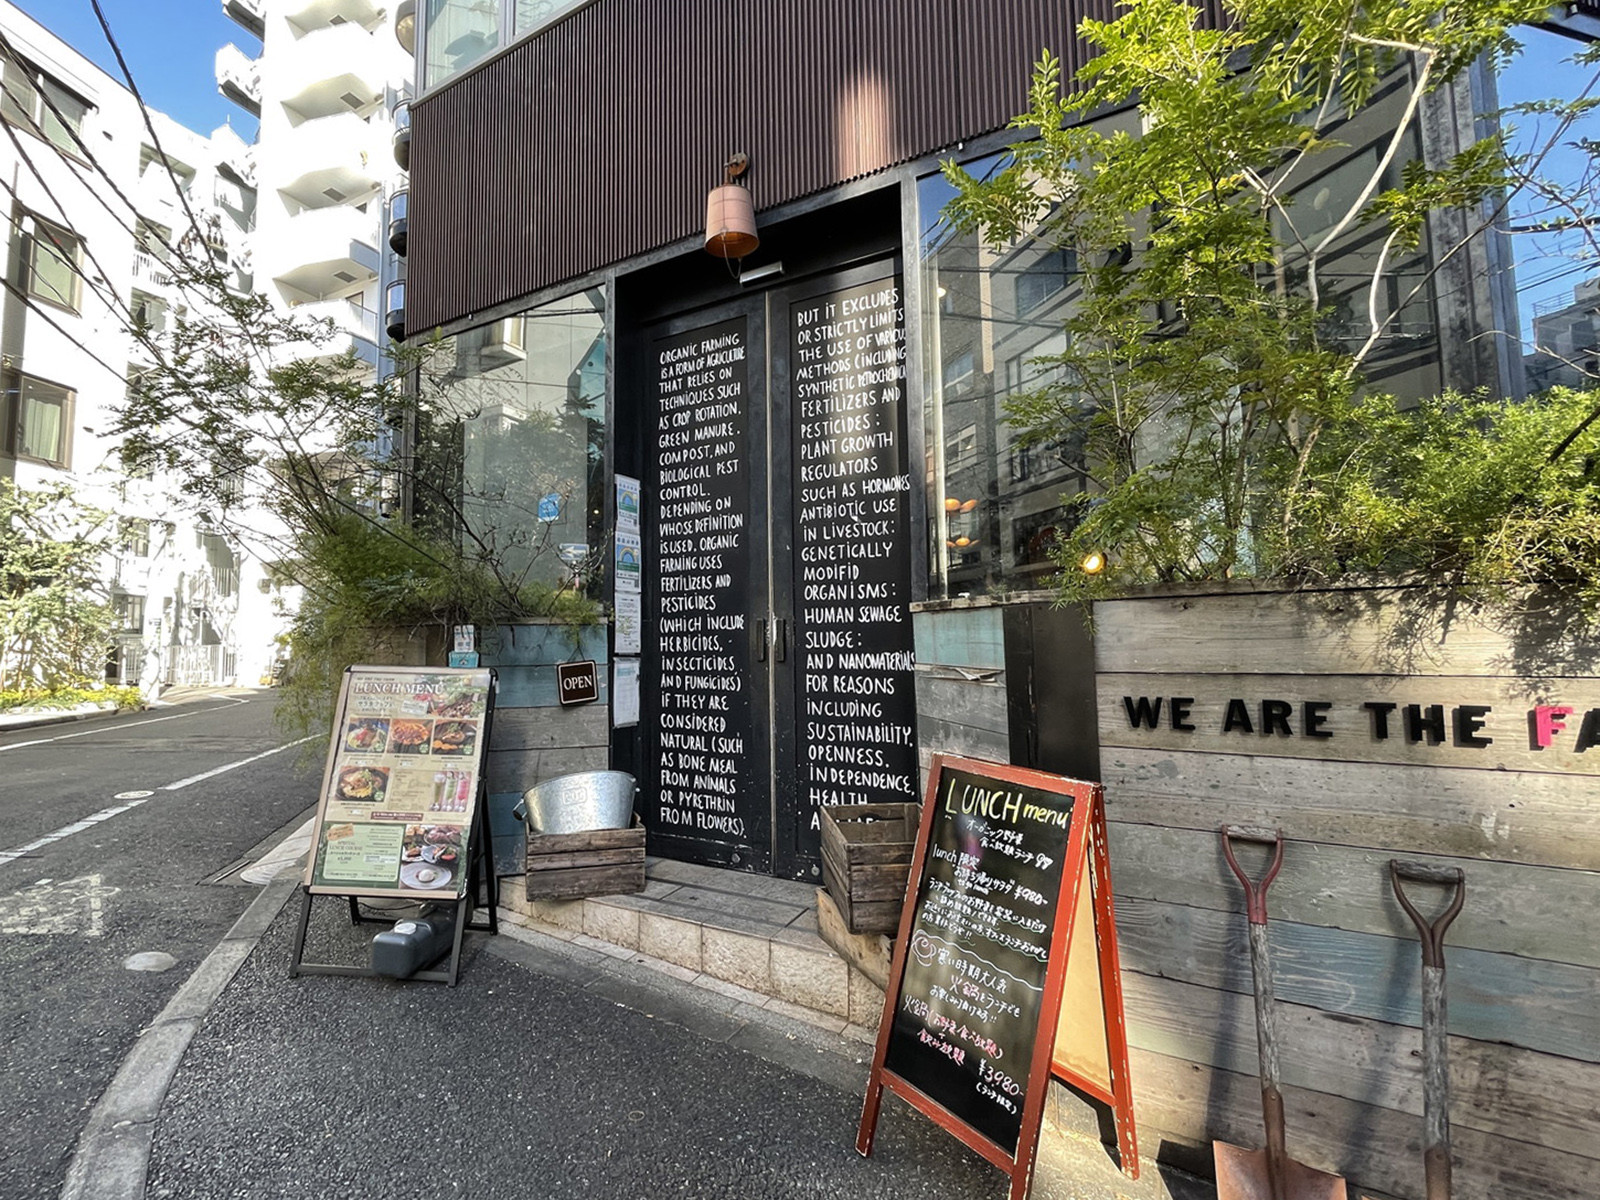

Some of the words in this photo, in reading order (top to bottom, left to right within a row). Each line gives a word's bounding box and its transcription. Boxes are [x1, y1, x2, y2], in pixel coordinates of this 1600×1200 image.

[798, 308, 819, 327] BUT
[825, 303, 836, 319] IT
[842, 288, 899, 316] EXCLUDES
[798, 330, 811, 345] OR
[814, 317, 867, 342] STRICTLY
[870, 308, 904, 329] LIMITS
[660, 342, 698, 364] ORGANIC
[702, 333, 740, 354] FARMING
[799, 347, 823, 363] THE
[827, 339, 852, 356] USE
[857, 333, 873, 350] OF
[661, 368, 668, 379] IS
[669, 366, 674, 377] A
[676, 360, 695, 376] FORM
[696, 358, 705, 370] OF
[796, 358, 851, 381] METHODS
[659, 378, 683, 394] THAT
[688, 372, 715, 388] RELIES
[719, 367, 732, 379] ON
[798, 374, 855, 398] SYNTHETIC
[660, 388, 714, 412] TECHNIQUES
[717, 382, 740, 399] SUCH
[802, 390, 877, 418] FERTILIZERS
[882, 386, 901, 403] AND
[659, 415, 669, 430] AS
[672, 410, 691, 427] CROP
[659, 430, 690, 448] GREEN
[802, 439, 837, 460] PLANT
[841, 431, 893, 453] GROWTH
[660, 465, 711, 485] BIOLOGICAL
[717, 459, 739, 476] PEST
[802, 456, 878, 482] REGULATORS
[801, 485, 836, 502] SUCH
[842, 482, 856, 498] AS
[863, 474, 910, 495] HORMONES
[661, 499, 712, 519] DEPENDING
[716, 496, 731, 510] ON
[800, 500, 866, 524] ANTIBIOTIC
[874, 498, 897, 513] USE
[660, 520, 693, 537] WHOSE
[695, 514, 743, 533] DEFINITION
[804, 526, 817, 542] IN
[661, 540, 668, 554] IS
[700, 532, 739, 551] ORGANIC
[802, 541, 893, 562] GENETICALLY
[661, 555, 697, 573] FARMING
[700, 554, 722, 570] USES
[804, 562, 859, 581] MODIFID
[661, 575, 712, 592] FERTILIZERS
[715, 574, 731, 588] AND
[661, 592, 716, 613] PESTICIDES
[661, 616, 702, 633] (WHICH
[707, 614, 744, 630] INCLUDE
[805, 607, 854, 624] HUMAN
[858, 605, 902, 623] SEWAGE
[807, 653, 833, 670] AND
[354, 682, 401, 695] LUNCH
[404, 683, 444, 695] MENU
[564, 675, 593, 691] OPEN
[661, 673, 681, 688] AND
[685, 675, 741, 691] FUNGICIDES)
[806, 674, 828, 693] FOR
[834, 675, 895, 695] REASONS
[662, 691, 671, 708] IF
[675, 694, 705, 709] THEY
[709, 695, 729, 710] ARE
[807, 698, 882, 718] INCLUDING
[661, 713, 726, 733] CONSIDERED
[1123, 697, 1196, 730] WE
[1223, 699, 1333, 737] ARE
[1365, 702, 1493, 745] THE
[661, 732, 708, 752] NATURAL
[712, 736, 743, 754] (SUCH
[661, 752, 674, 767] AS
[679, 753, 705, 772] BONE
[709, 758, 738, 774] MEAL
[661, 770, 689, 787] FROM
[694, 775, 736, 794] ANIMALS
[661, 790, 674, 804] OR
[679, 791, 735, 813] PYRETHRIN
[945, 778, 1023, 824] LUNCH
[1023, 803, 1070, 829] menu
[661, 807, 692, 826] FROM
[932, 844, 957, 863] lunch
[938, 947, 1007, 994] 寒い時期大人気
